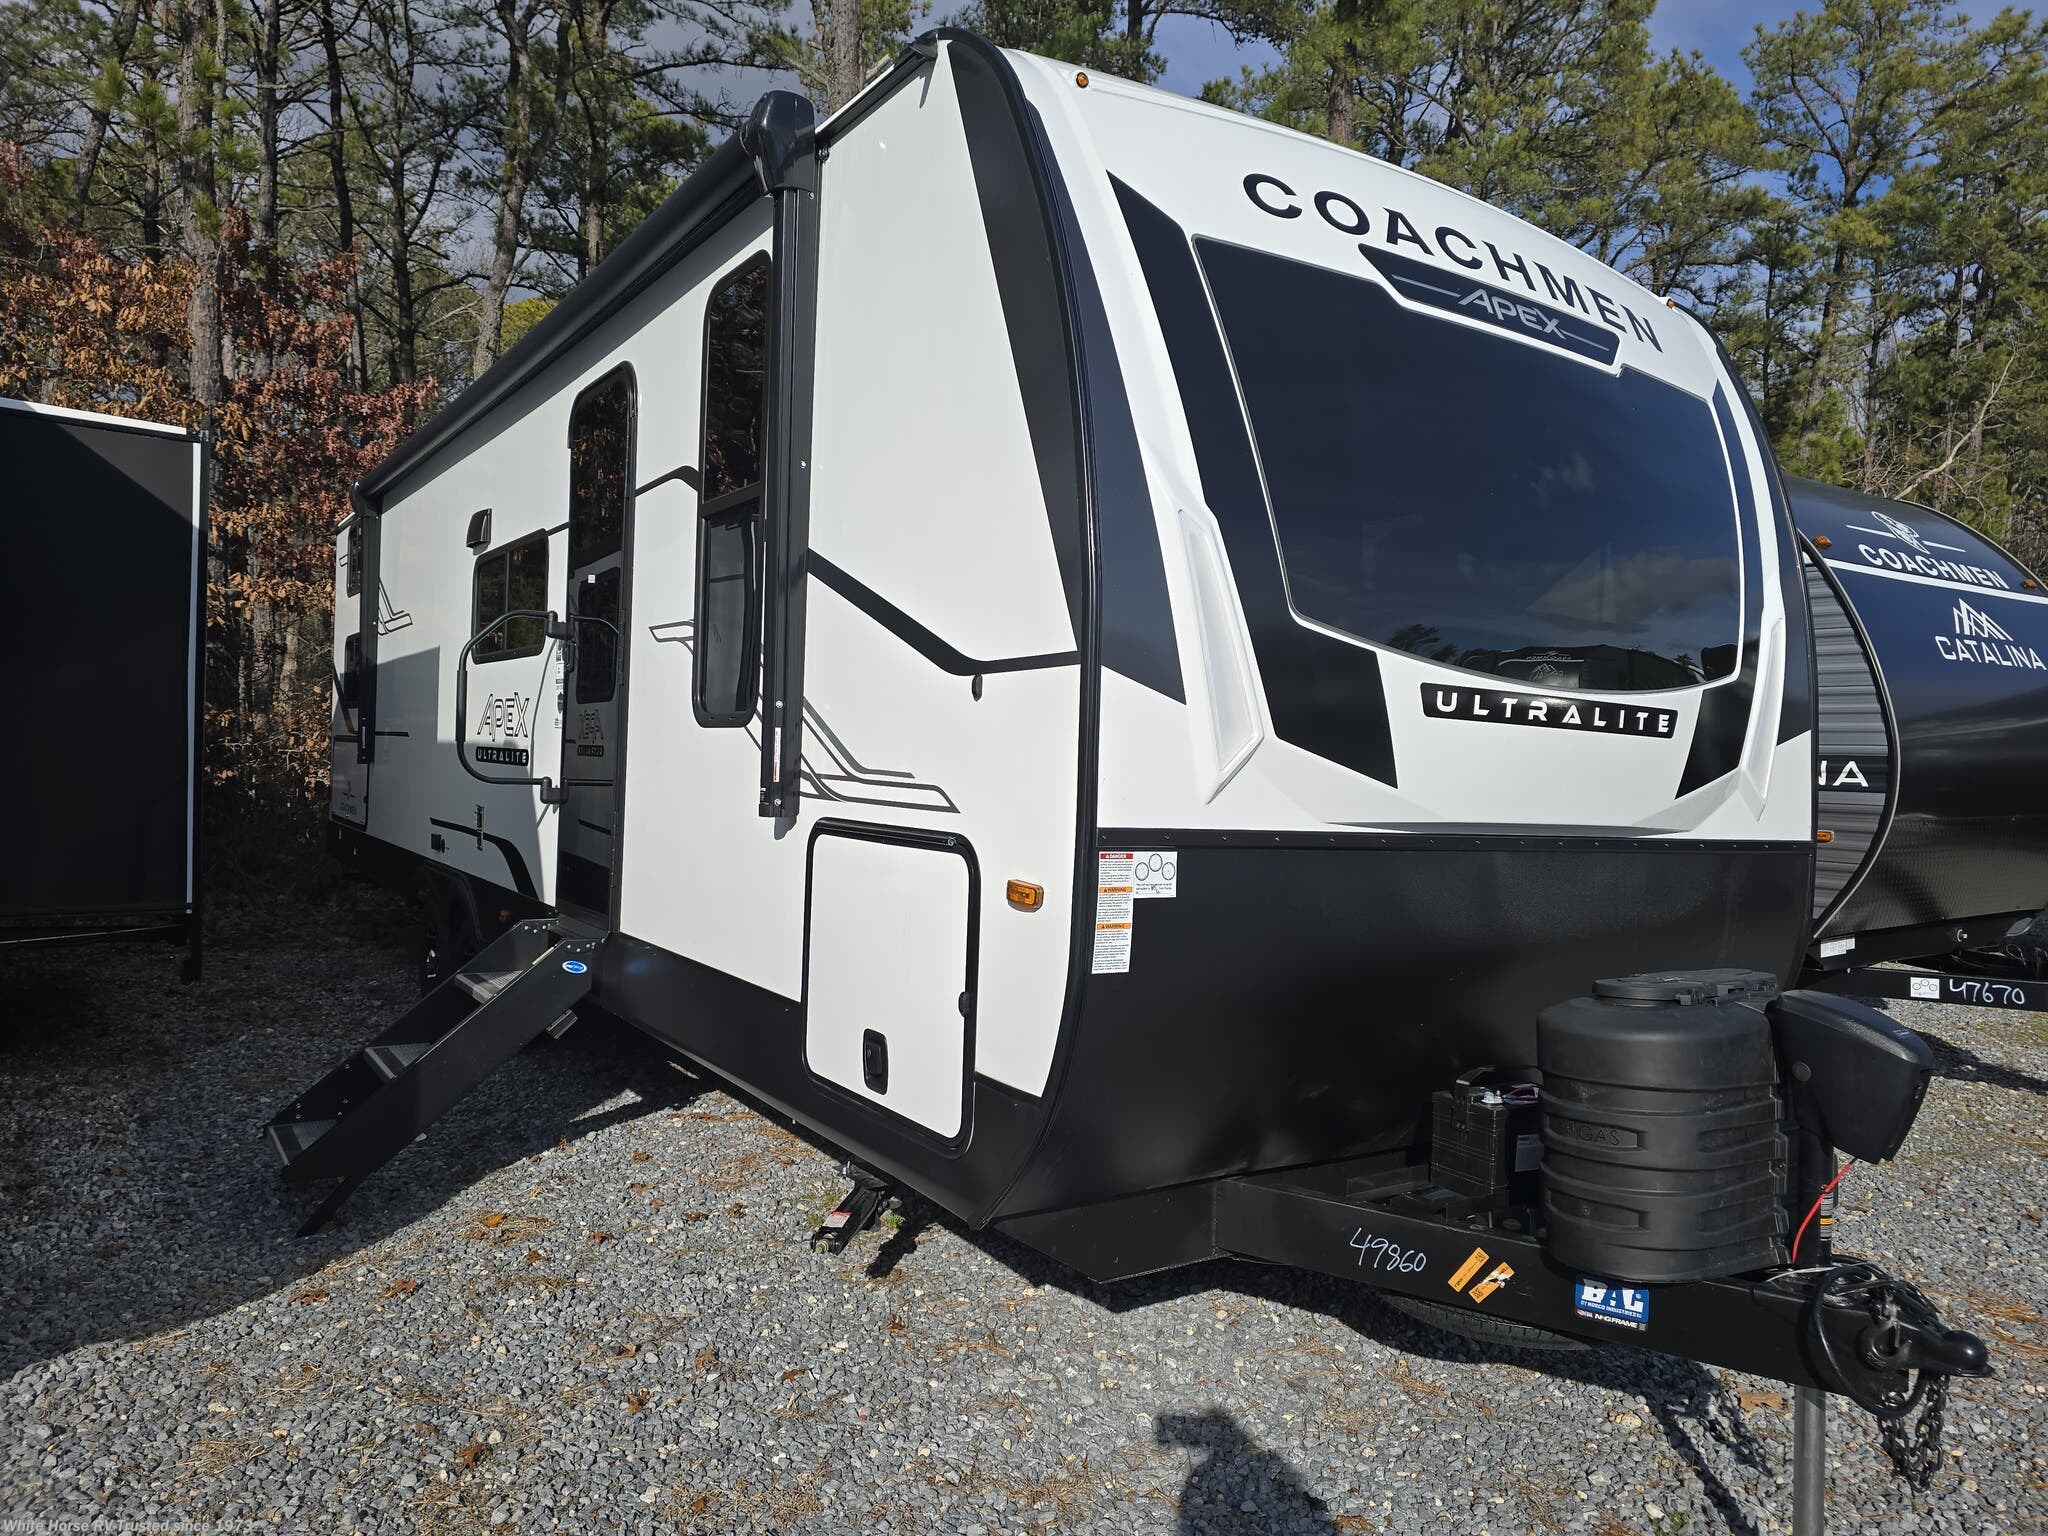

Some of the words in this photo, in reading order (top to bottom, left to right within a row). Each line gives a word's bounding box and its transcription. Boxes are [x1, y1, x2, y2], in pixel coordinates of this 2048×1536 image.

[1242, 173, 1664, 354] COACHMEN
[1458, 288, 1566, 340] APEX
[1858, 544, 2010, 590] COACHMEN
[1935, 635, 2048, 670] CATALINA
[477, 692, 530, 742] APEX
[1436, 690, 1671, 733] ULTRALITE
[477, 749, 527, 764] ULTRALITE
[1949, 978, 2025, 1005] 47670
[1350, 1228, 1427, 1272] 49860
